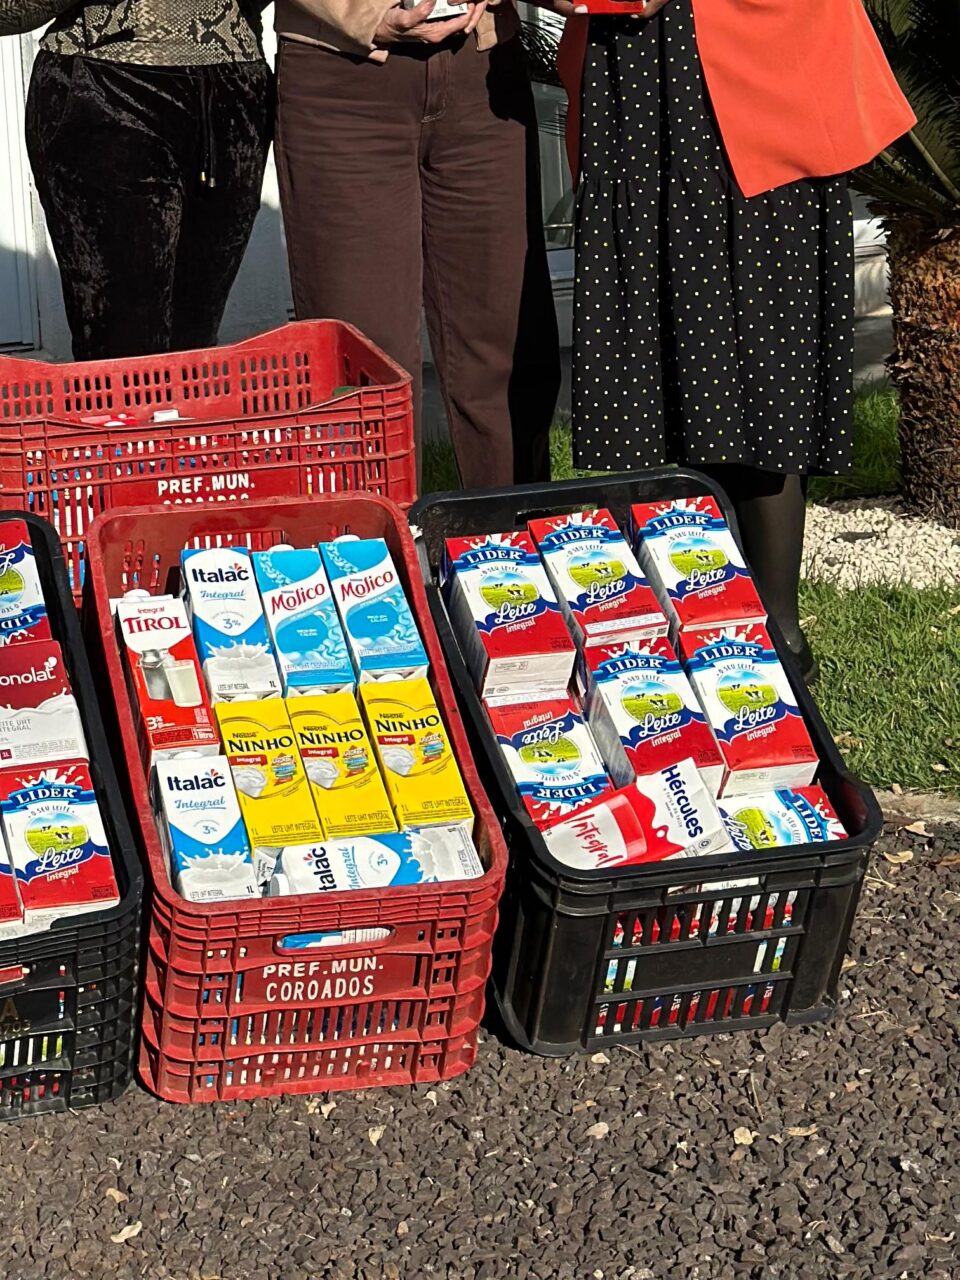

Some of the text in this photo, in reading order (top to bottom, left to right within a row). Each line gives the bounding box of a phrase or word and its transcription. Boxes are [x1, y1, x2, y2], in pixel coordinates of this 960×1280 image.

[653, 515, 708, 530] LIDER
[550, 530, 604, 544] LIDER
[467, 549, 522, 564] LIDER
[192, 568, 250, 583] Italac
[686, 568, 726, 591] Leite
[200, 590, 246, 599] Integral
[340, 571, 393, 602] Molico
[586, 581, 626, 604] Leite
[698, 584, 726, 599] integral
[271, 583, 325, 615] Molico
[599, 595, 627, 612] integral
[137, 606, 165, 615] Integral
[495, 602, 536, 624] Leite
[123, 616, 187, 635] TIROL
[505, 618, 535, 634] integral
[701, 646, 757, 661] LIDER
[605, 658, 661, 673] LIDER
[375, 714, 439, 733] NINHO
[523, 712, 553, 729] integral
[639, 713, 681, 736] Leite
[734, 705, 776, 731] Leite
[299, 729, 364, 745] NINHO
[522, 721, 565, 744] Leite
[651, 729, 681, 747] integral
[747, 723, 776, 741] integral
[228, 736, 293, 753] NINHO
[167, 775, 226, 791] Italac
[537, 783, 597, 798] LIDER
[16, 788, 76, 803] LIDER
[175, 797, 225, 810] Integral
[661, 765, 703, 838] Hércules
[564, 814, 624, 868] Integral
[36, 847, 84, 873] Leite
[47, 865, 79, 882] integral
[266, 976, 374, 1002] COROADOS
